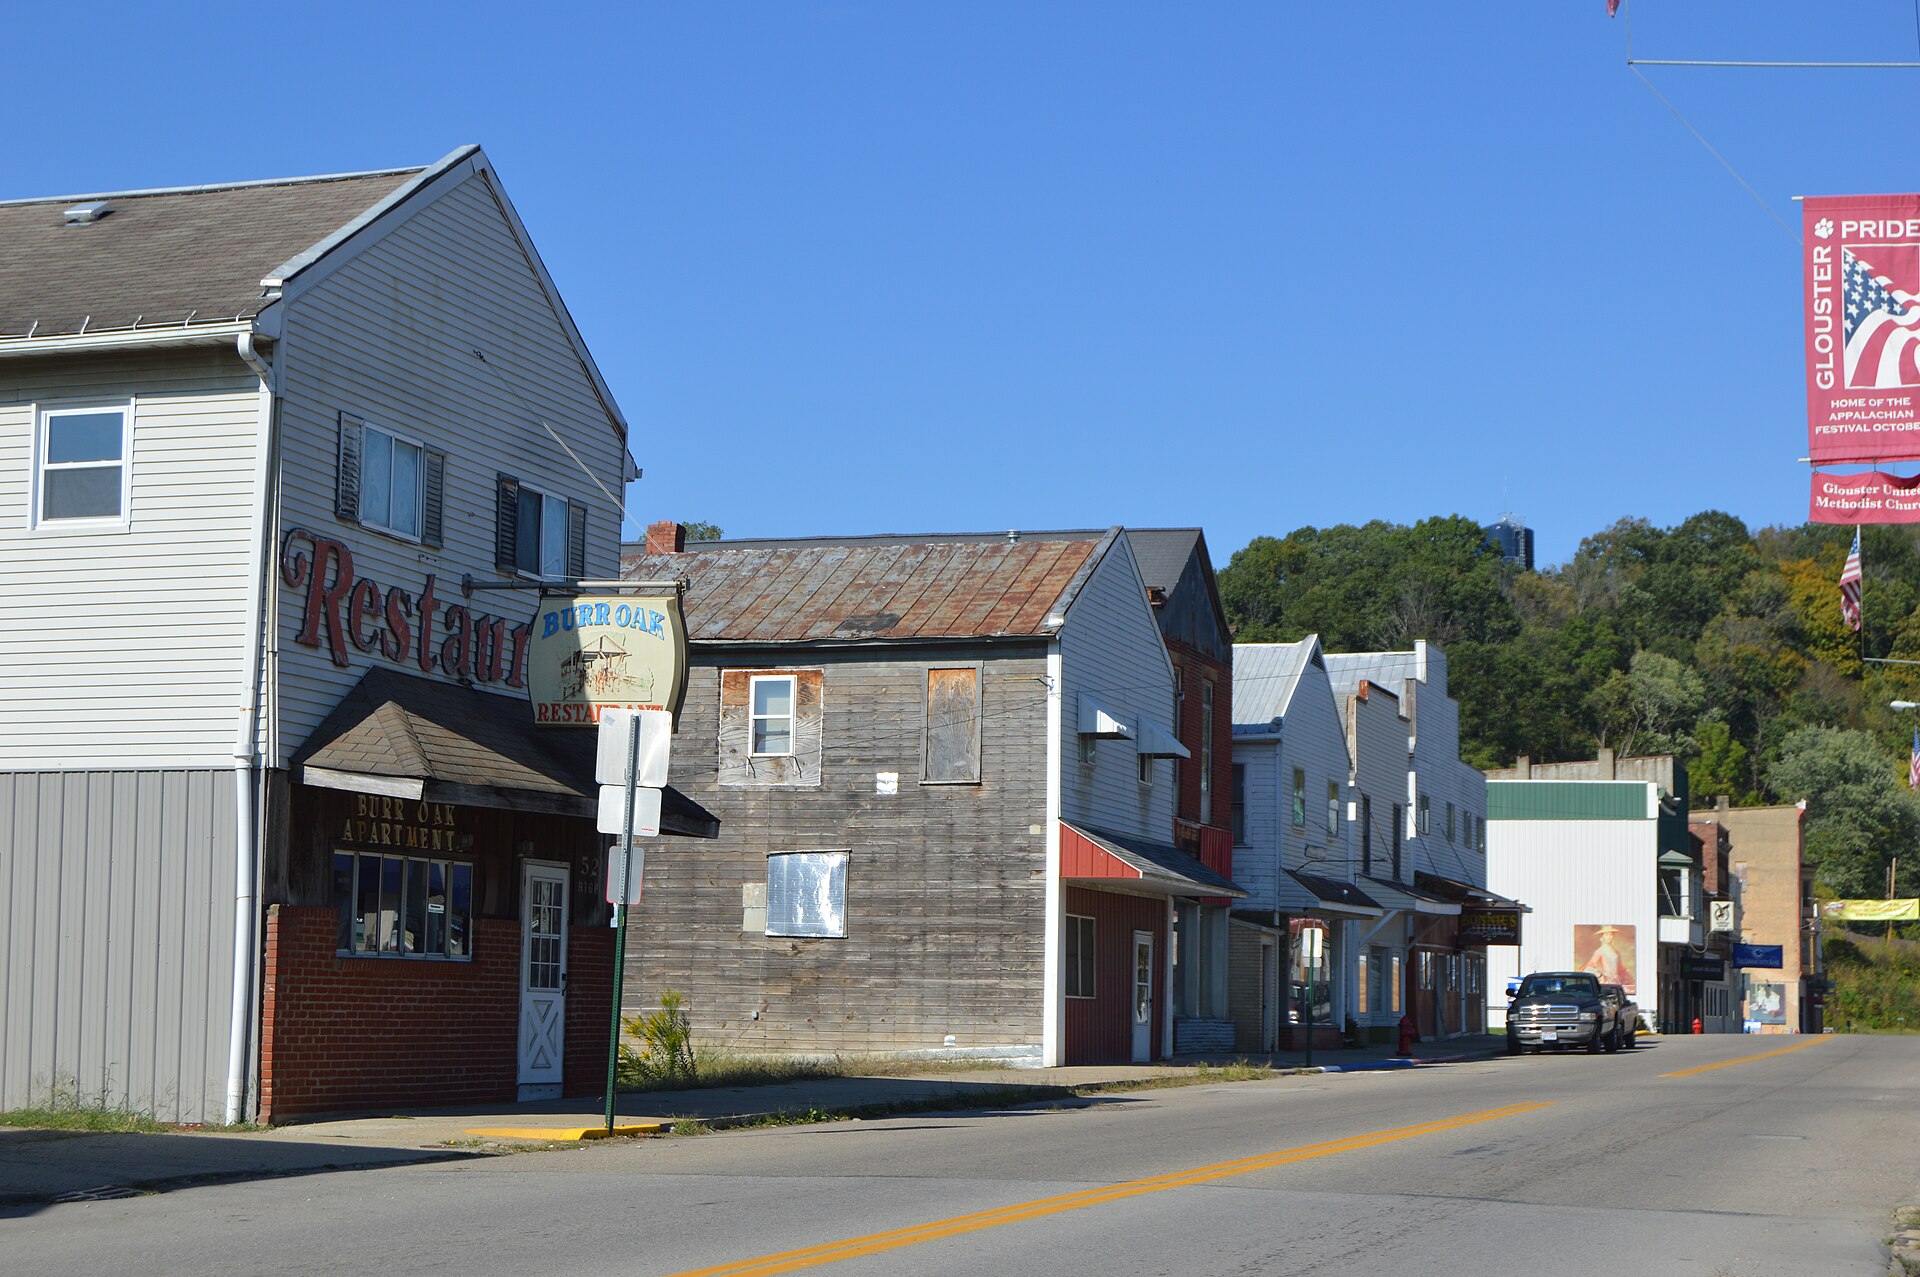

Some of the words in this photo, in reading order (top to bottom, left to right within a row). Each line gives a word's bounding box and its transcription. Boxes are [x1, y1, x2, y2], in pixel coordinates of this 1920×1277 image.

[1841, 219, 1920, 239] PRIDE
[1813, 245, 1834, 390] GLOUSTER
[1831, 399, 1866, 408] HOME
[1868, 398, 1885, 407] OF
[1886, 397, 1911, 406] THE
[1829, 410, 1914, 421] APPALACHIAN
[1815, 424, 1870, 435] FESTIVAL
[1823, 483, 1879, 495] Glouster
[1816, 496, 1882, 509] Methodist
[1885, 498, 1920, 510] Chur
[542, 603, 610, 640] BURR
[615, 604, 665, 640] OAK
[537, 703, 664, 723] RESTA
[357, 794, 404, 820] BURR
[417, 801, 455, 826] OAK
[341, 818, 464, 852] APARTMENT
